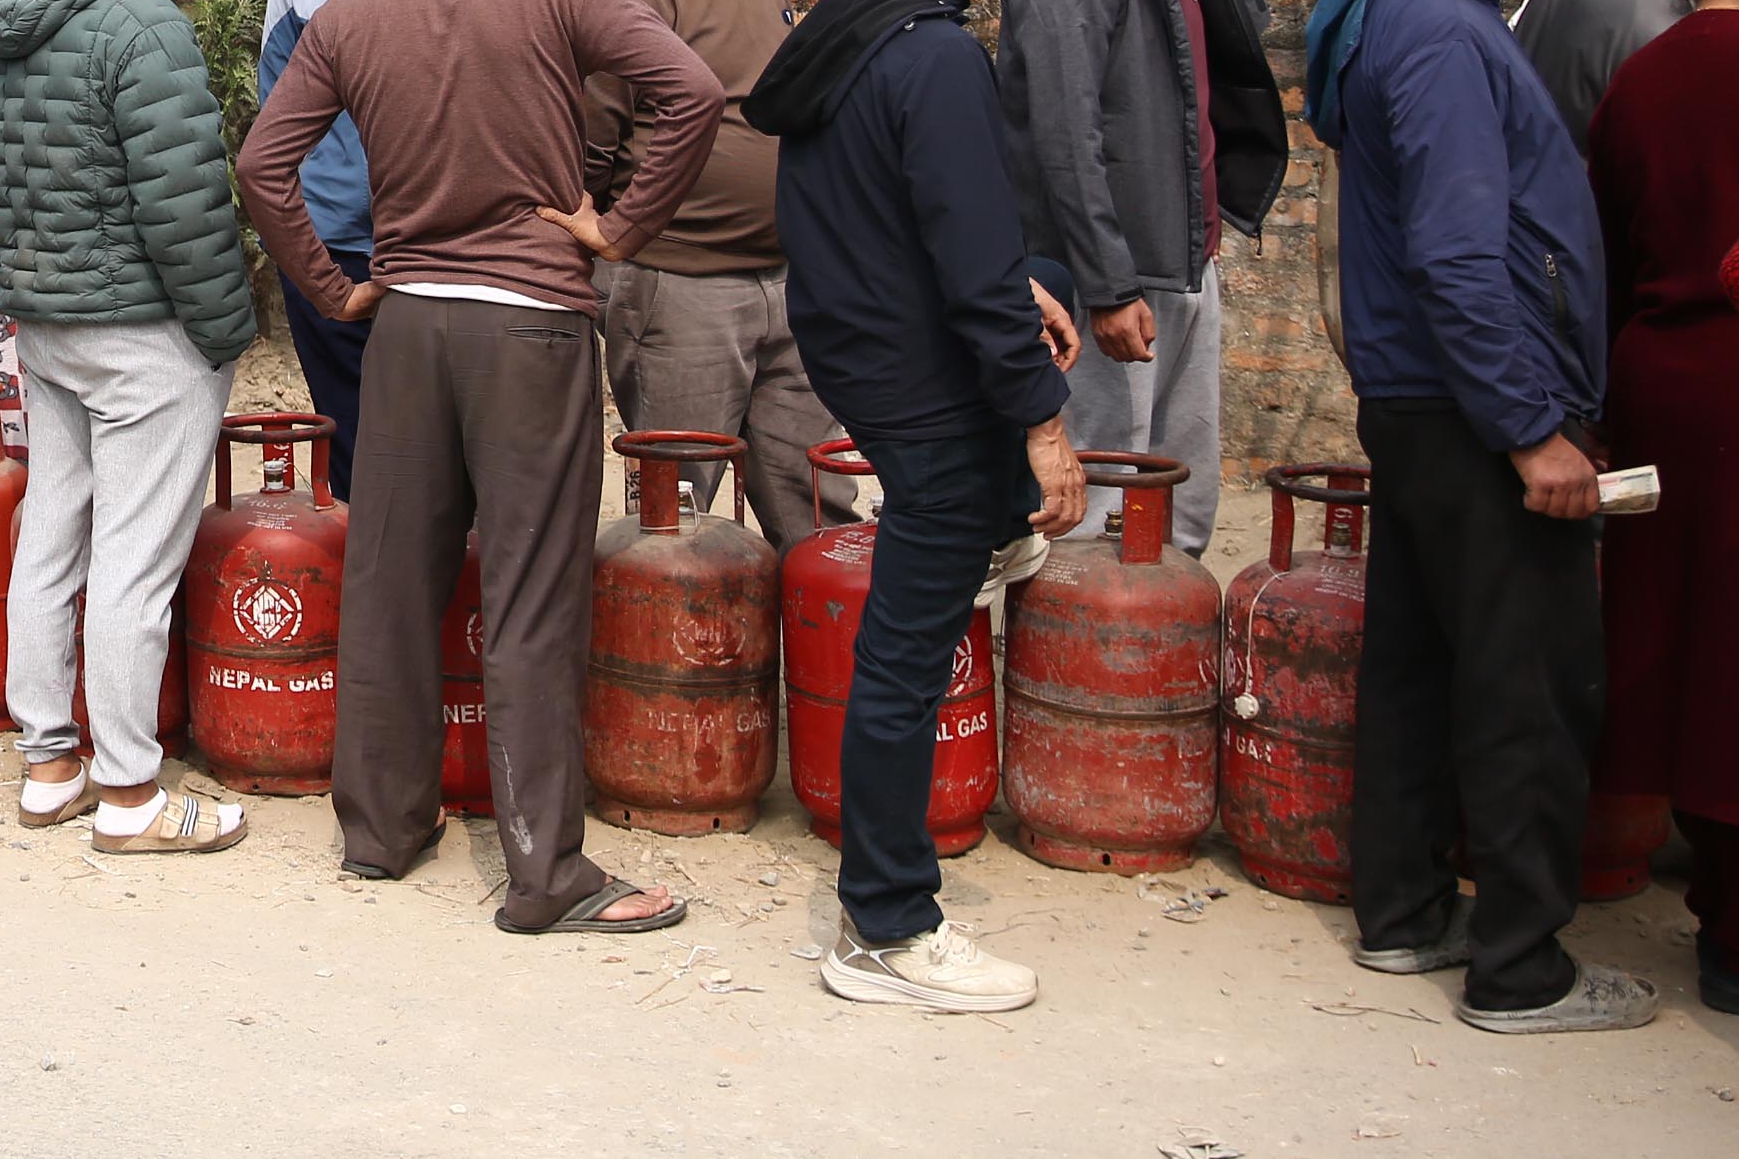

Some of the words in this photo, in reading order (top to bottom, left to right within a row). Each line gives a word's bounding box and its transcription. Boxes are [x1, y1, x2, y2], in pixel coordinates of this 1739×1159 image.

[209, 665, 281, 692] NEPAL
[289, 670, 334, 692] GAS
[736, 710, 771, 733] GAS
[957, 711, 988, 738] GAS
